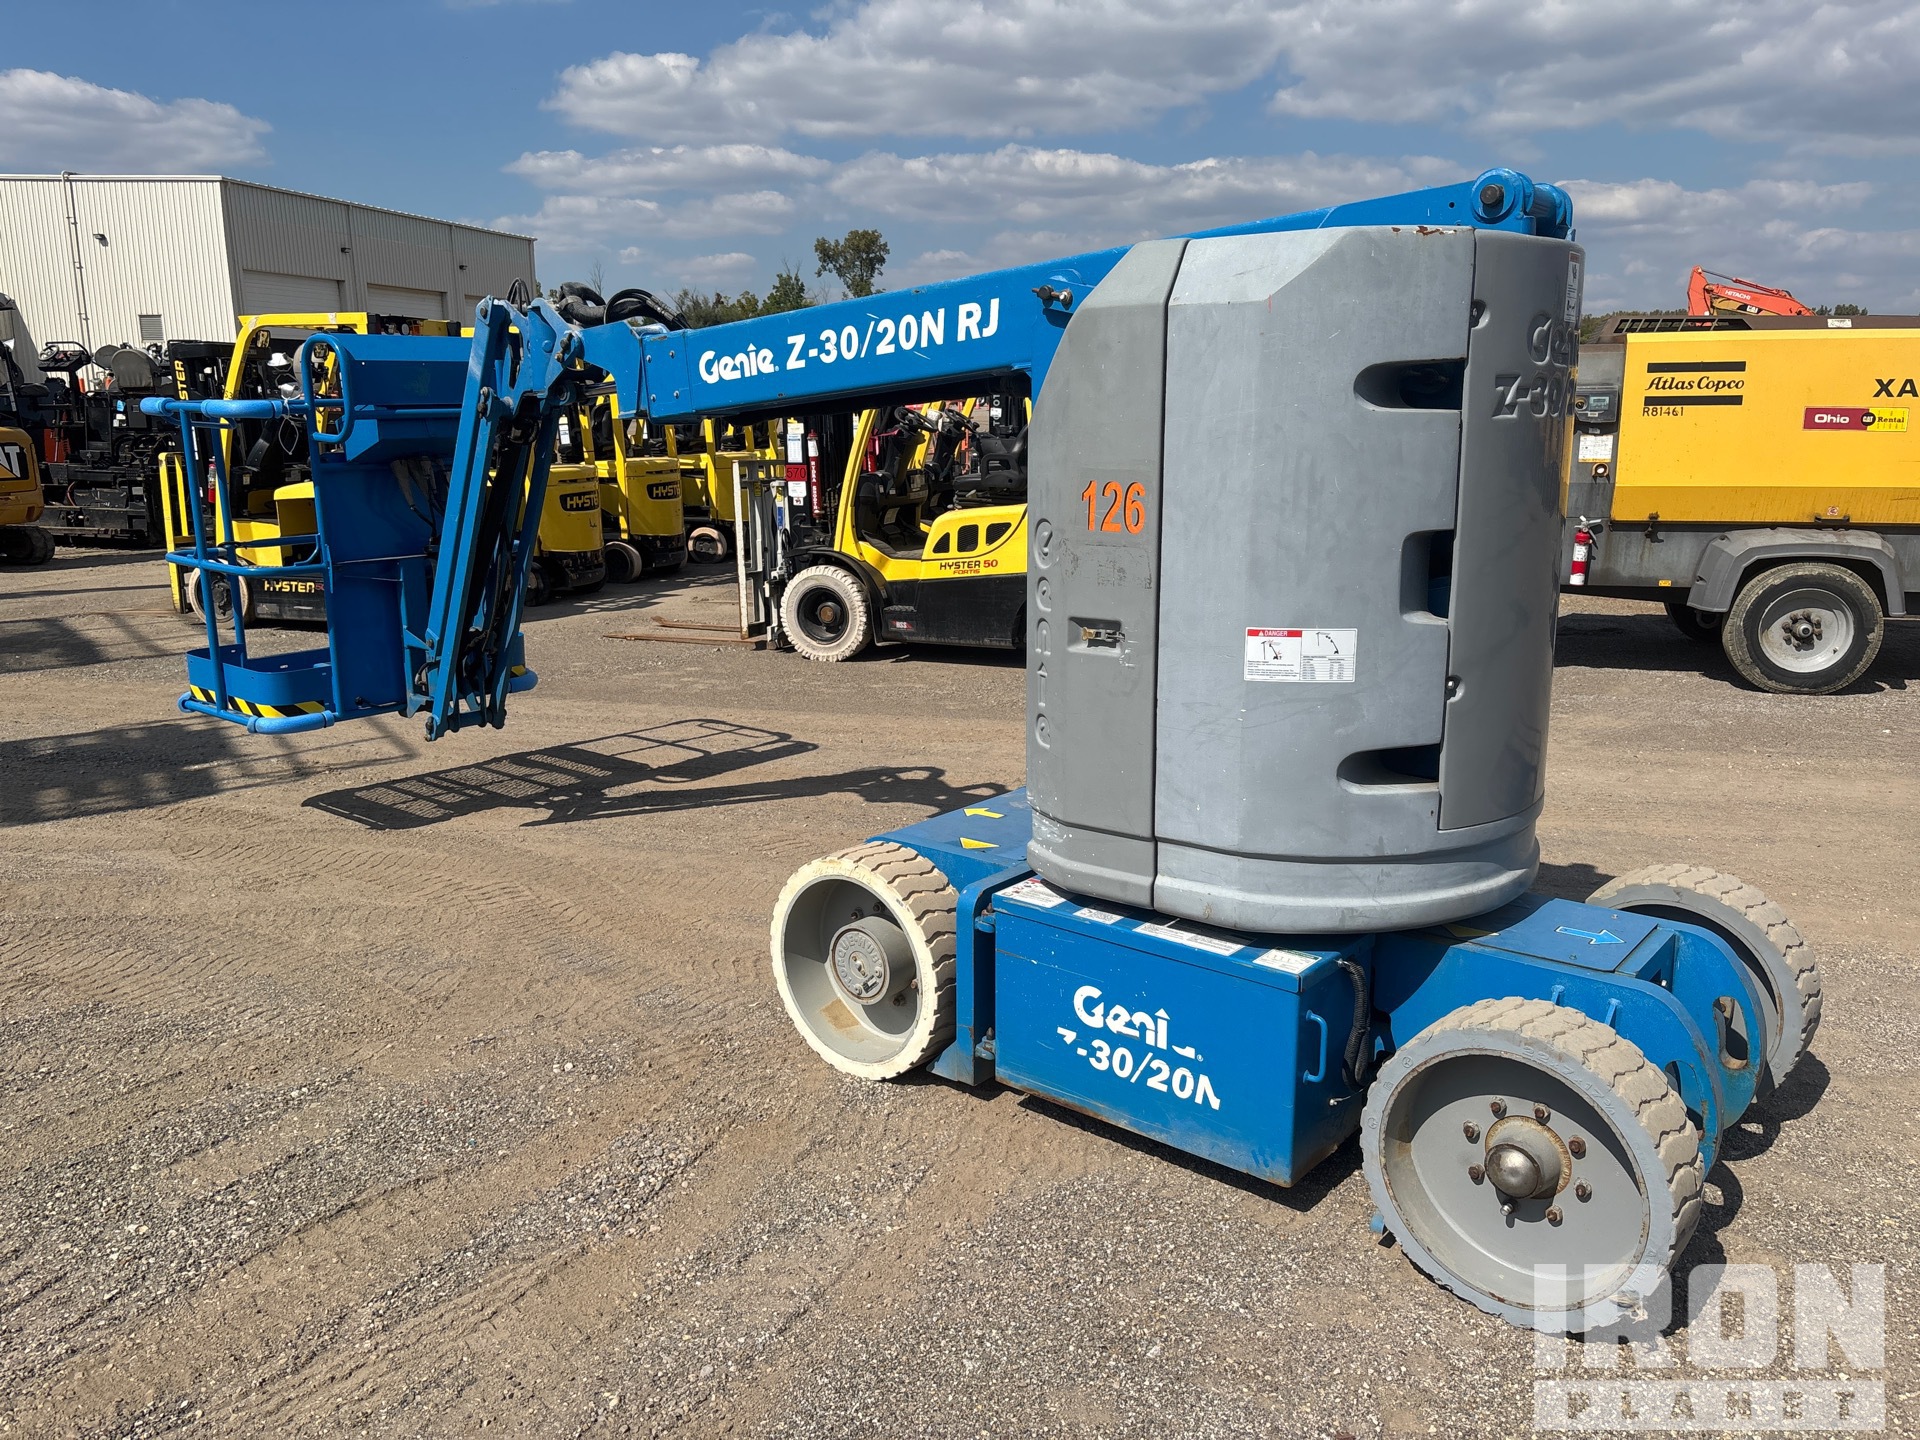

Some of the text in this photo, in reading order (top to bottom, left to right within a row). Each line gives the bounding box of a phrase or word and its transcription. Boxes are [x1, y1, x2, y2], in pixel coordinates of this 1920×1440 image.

[1724, 289, 1751, 301] HITACHI
[699, 298, 1000, 384] Genie Z-30/20N RJ
[1645, 376, 1745, 392] Atlas Copco
[1873, 378, 1919, 398] XA
[1642, 406, 1684, 416] R81461
[1814, 413, 1849, 424] Ohio
[786, 467, 806, 478] 570
[1081, 480, 1146, 535] 126
[940, 559, 998, 570] HYSTER 50
